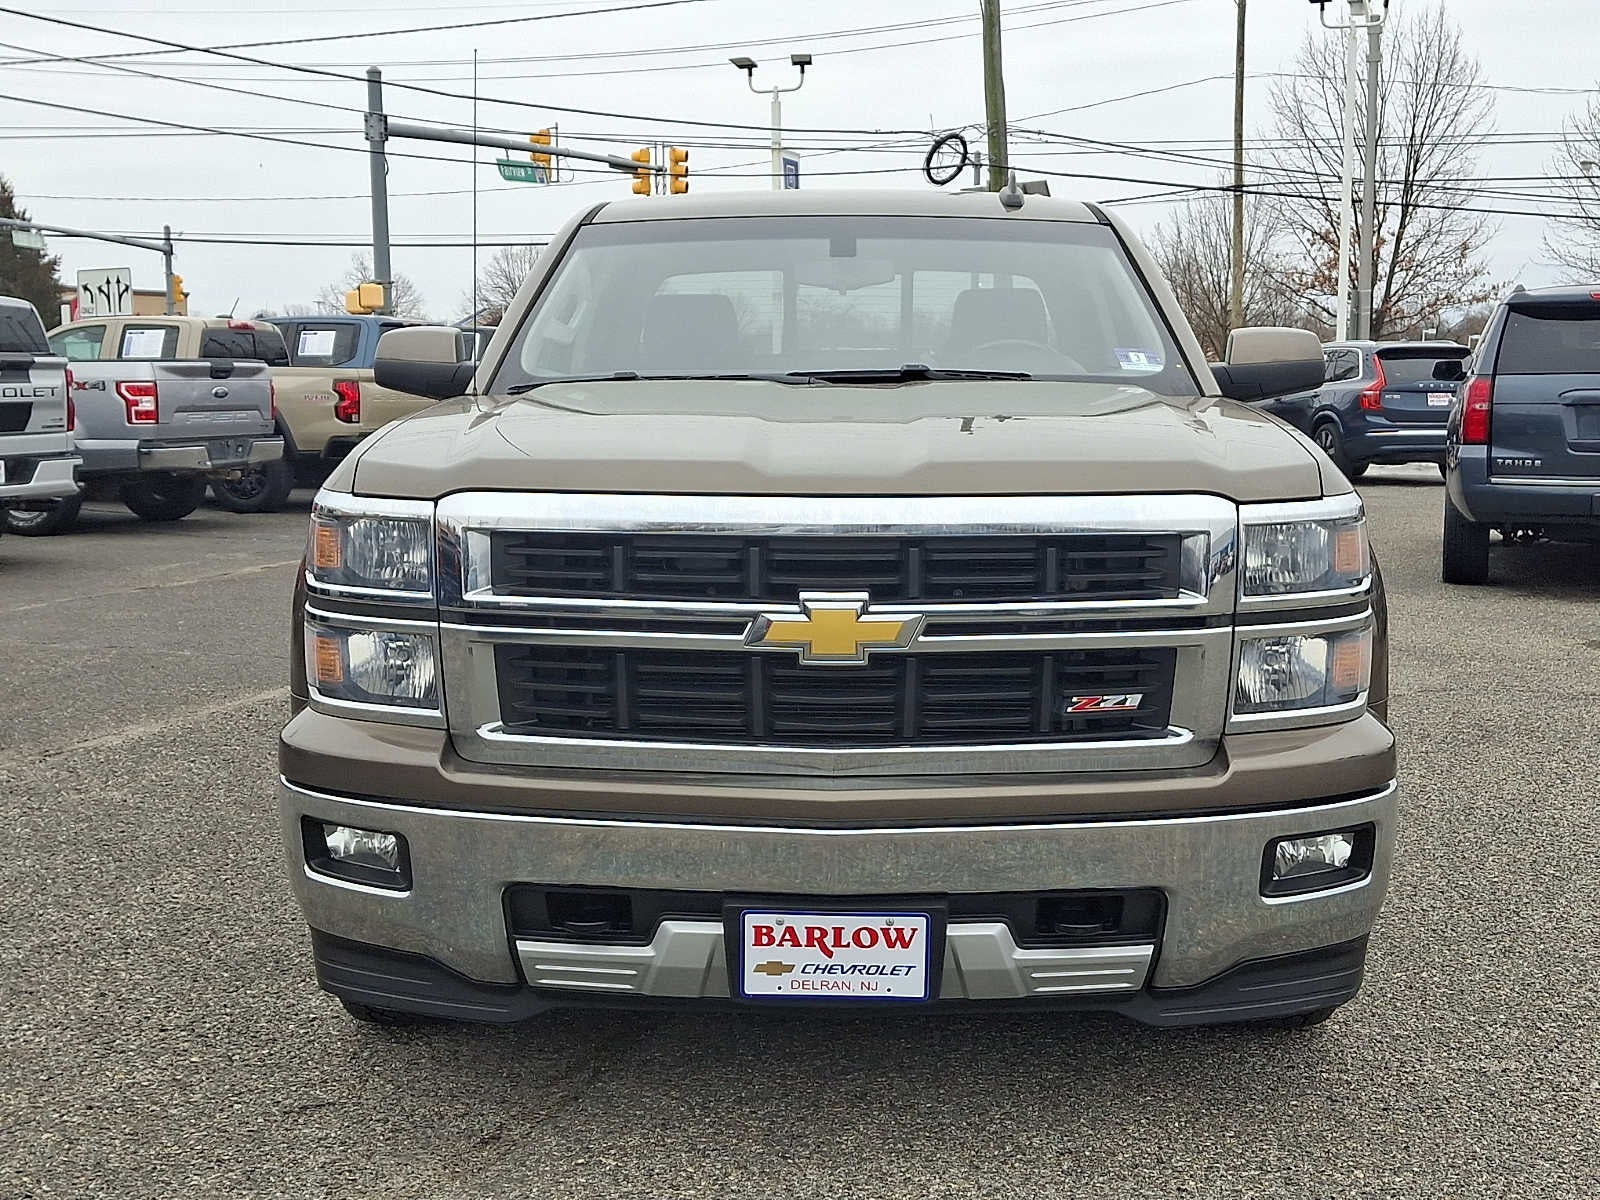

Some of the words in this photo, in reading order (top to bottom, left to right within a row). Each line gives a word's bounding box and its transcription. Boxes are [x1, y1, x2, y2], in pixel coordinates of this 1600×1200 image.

[1496, 459, 1542, 467] TAHOE
[1066, 693, 1144, 713] Z71
[751, 925, 919, 959] BARLOW
[800, 963, 917, 976] CHEVROLET
[790, 979, 855, 992] DELRAN,
[860, 981, 880, 992] NJ
